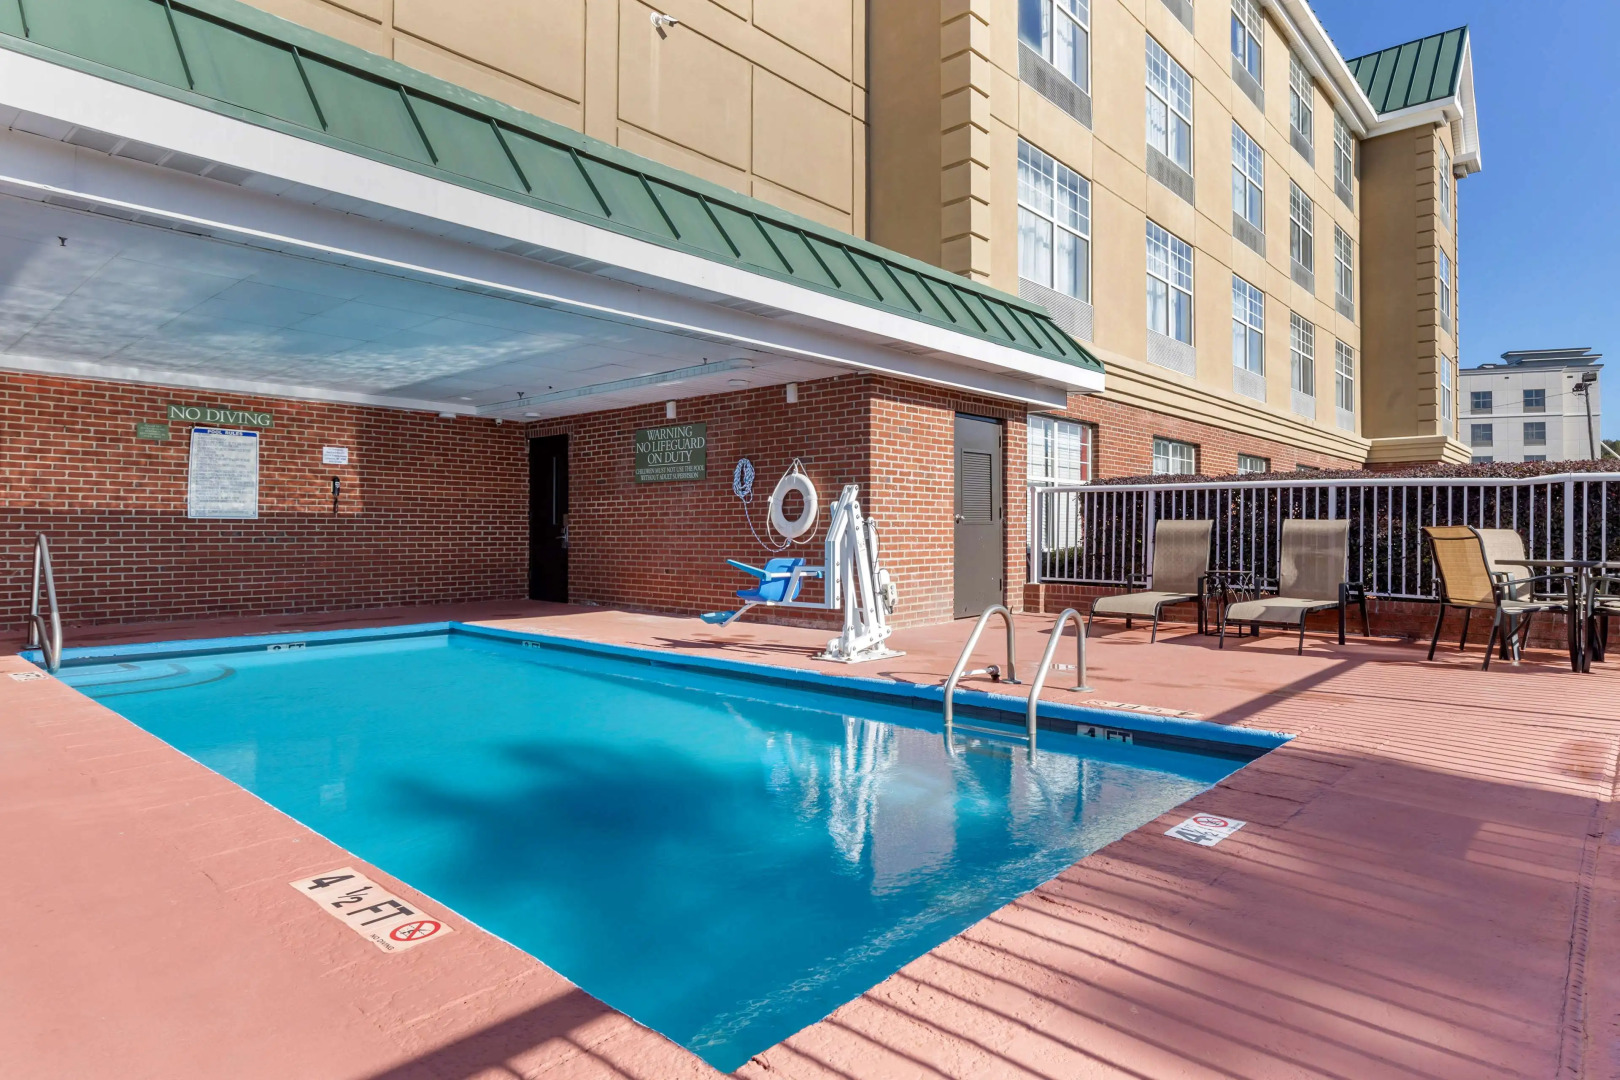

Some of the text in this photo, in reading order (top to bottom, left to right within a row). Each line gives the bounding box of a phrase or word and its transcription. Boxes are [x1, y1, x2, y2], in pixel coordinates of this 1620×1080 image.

[169, 405, 270, 426] NO DIVING
[646, 425, 693, 441] WARNING
[636, 436, 705, 454] NO LIFEGUARD
[647, 450, 693, 465] ON DUTY
[673, 471, 699, 480] SUPERVISION
[693, 464, 705, 472] POOL
[1106, 729, 1131, 743] FT
[1175, 829, 1213, 843] 4
[307, 874, 355, 891] 4
[346, 899, 415, 927] FT
